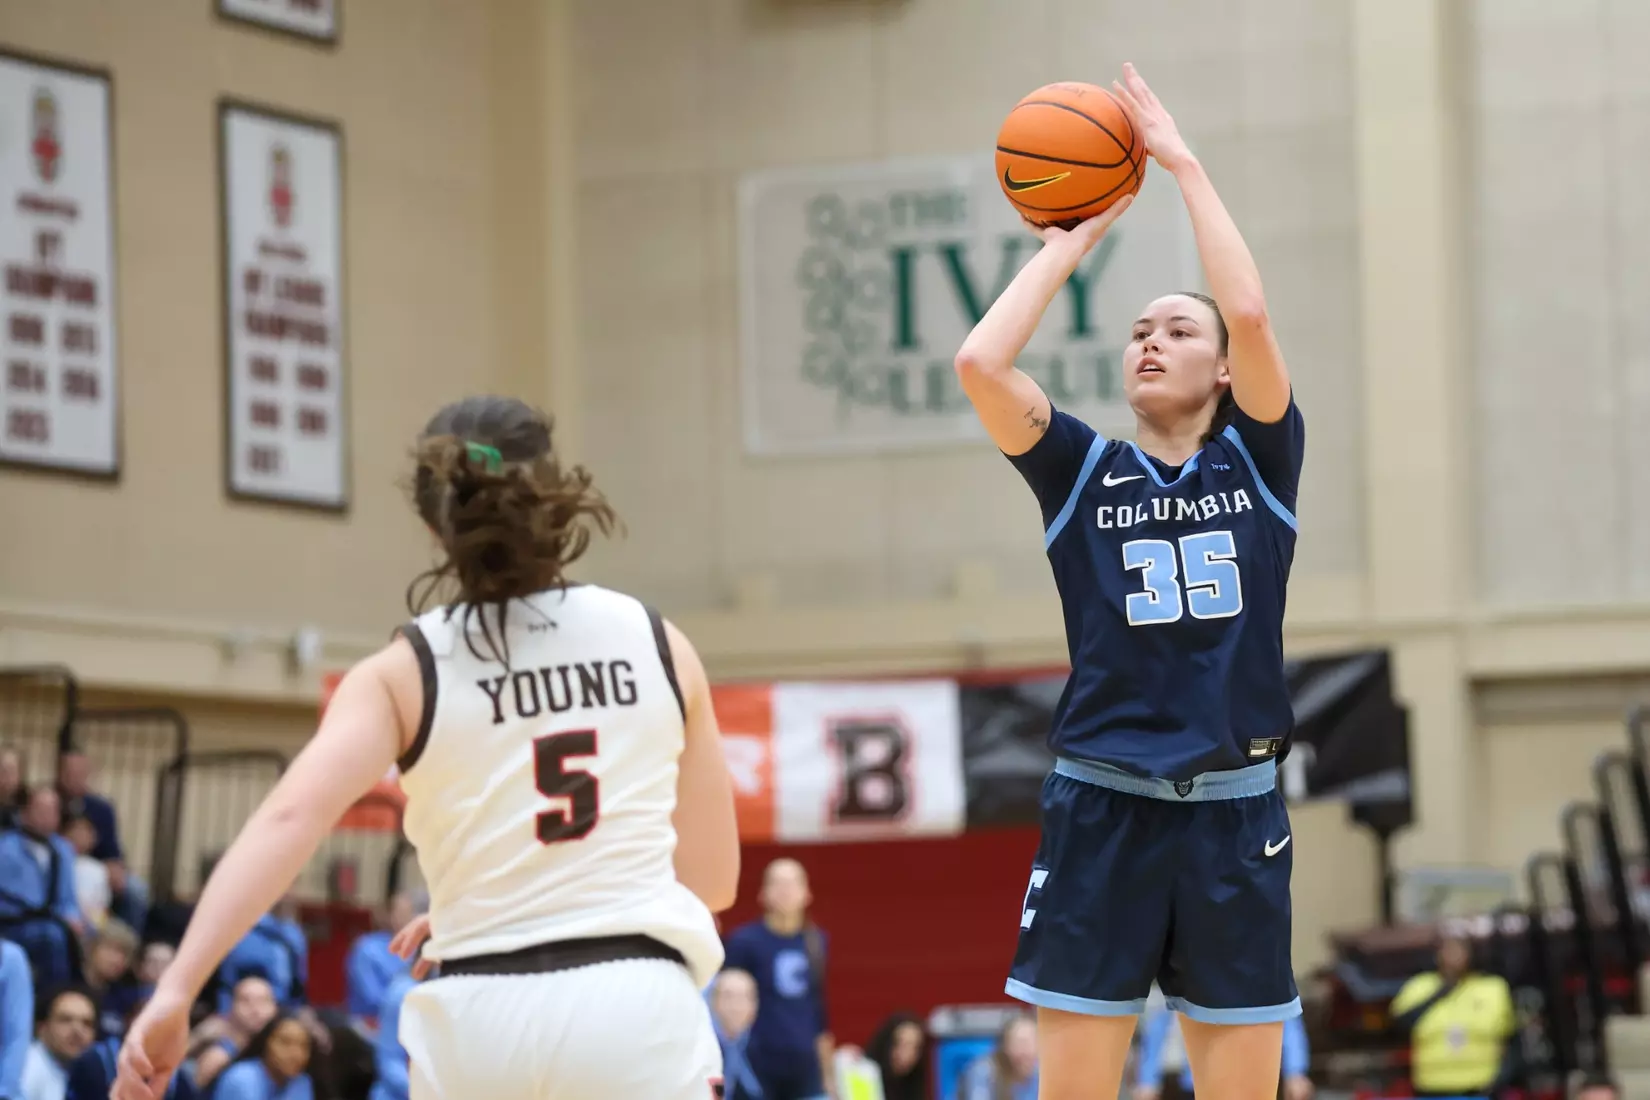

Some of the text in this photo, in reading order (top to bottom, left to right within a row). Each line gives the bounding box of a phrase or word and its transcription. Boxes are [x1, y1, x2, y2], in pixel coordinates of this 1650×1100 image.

[888, 233, 1120, 351] IVY
[1096, 488, 1253, 529] COLUMBIA
[1121, 530, 1244, 627] 35
[476, 659, 638, 725] YOUNG
[532, 728, 600, 846] 5
[823, 714, 918, 826] B
